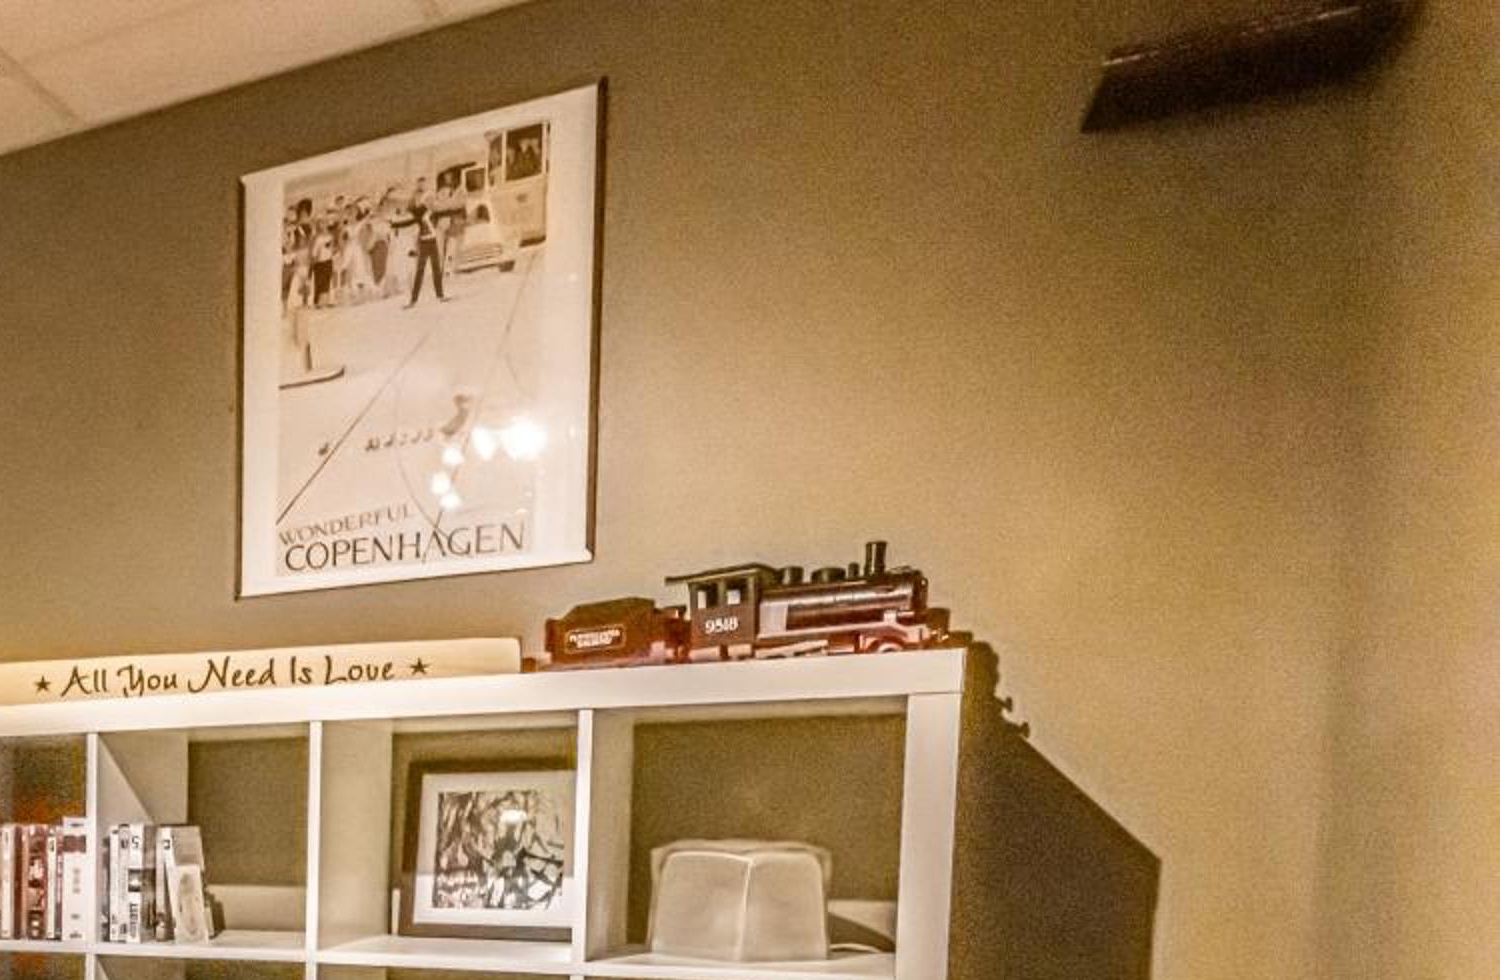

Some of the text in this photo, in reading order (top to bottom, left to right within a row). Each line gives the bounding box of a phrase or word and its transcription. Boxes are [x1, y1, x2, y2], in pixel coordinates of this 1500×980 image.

[279, 503, 413, 547] WONDERFUL
[284, 521, 525, 572] COPENHAGEN
[60, 655, 394, 698] All You Need Is Love
